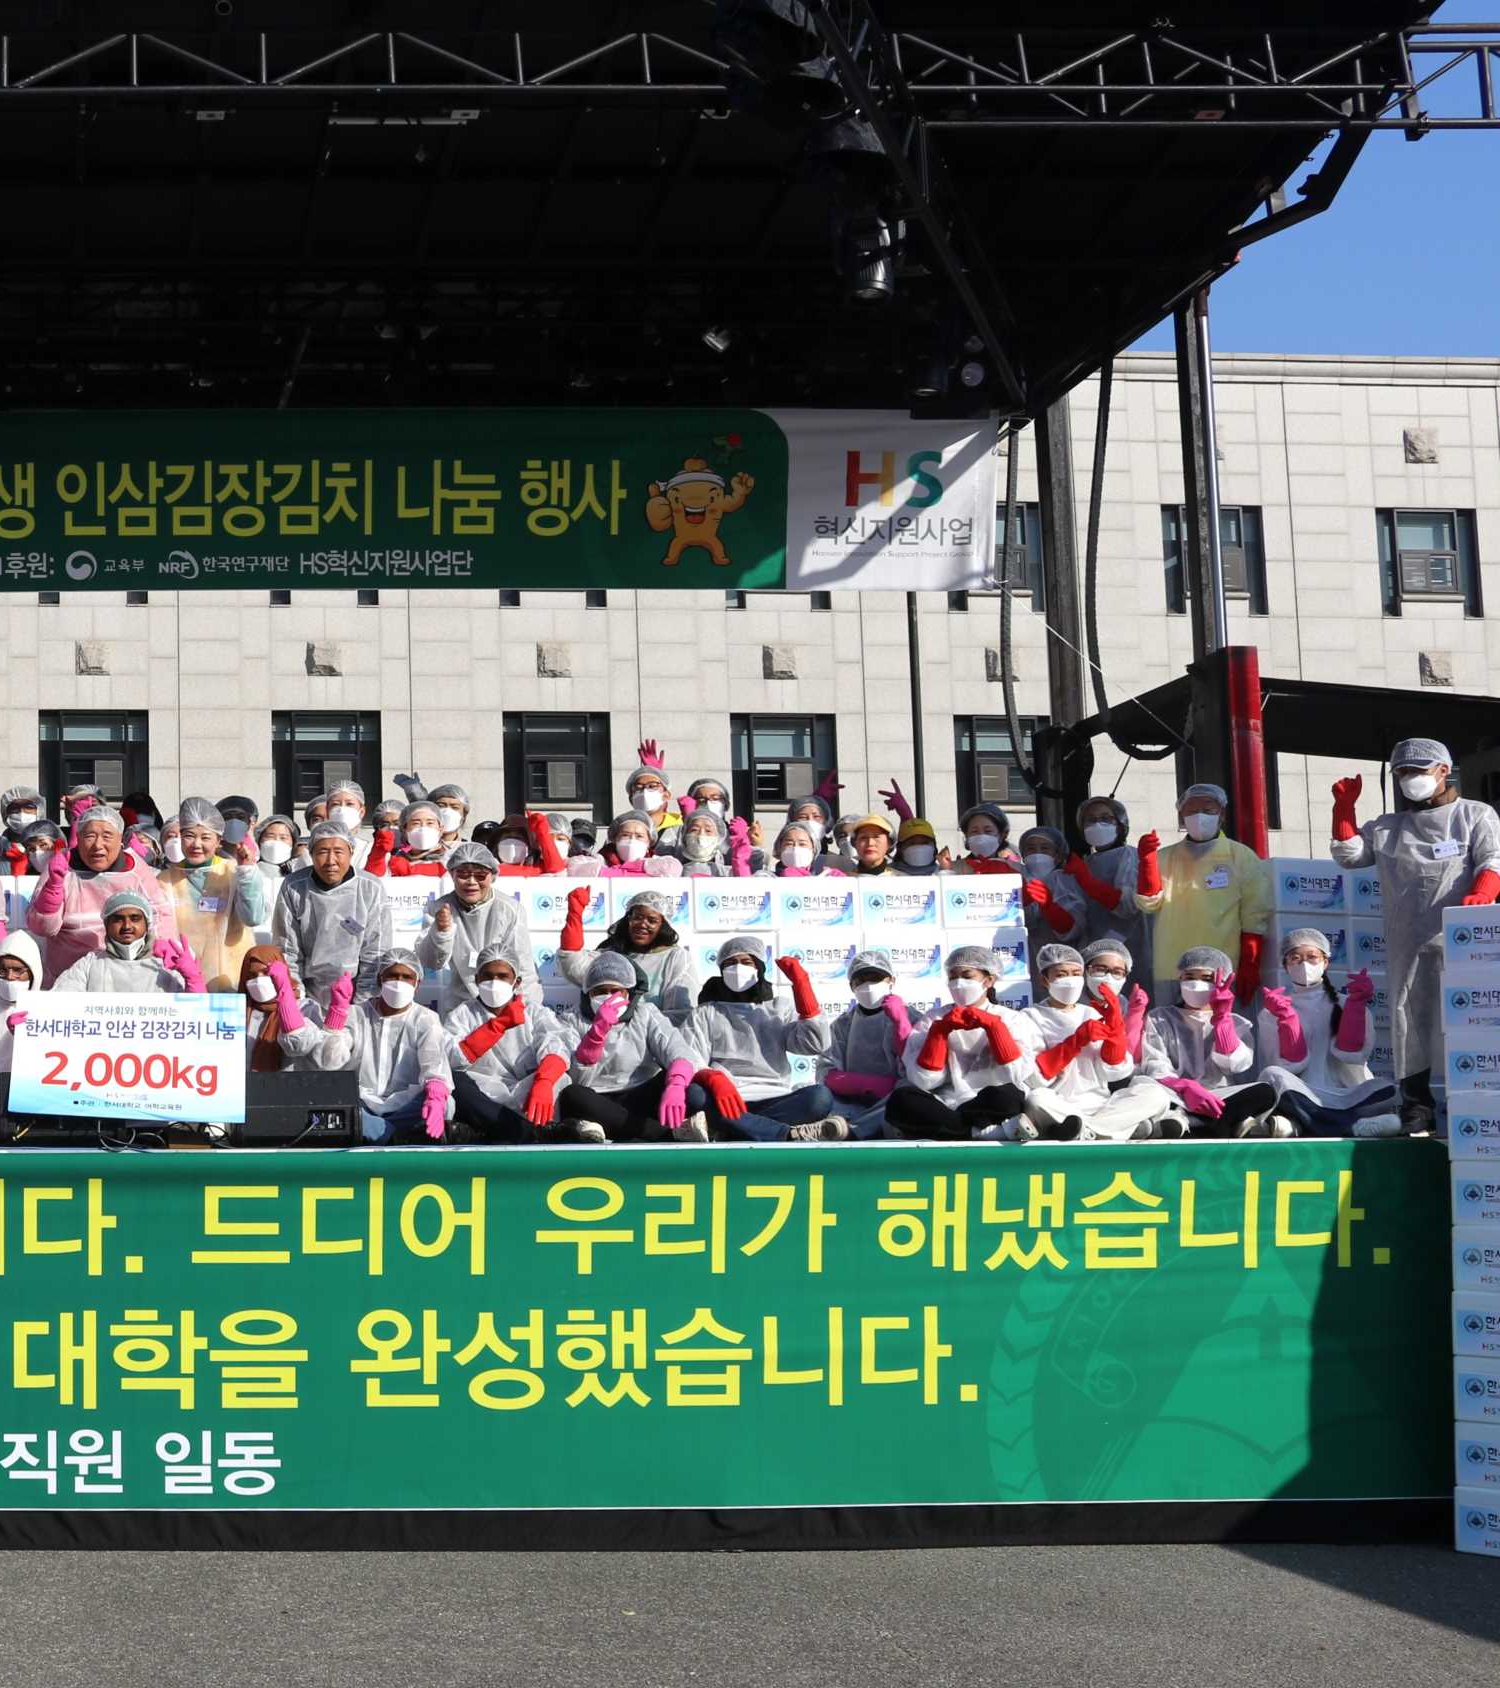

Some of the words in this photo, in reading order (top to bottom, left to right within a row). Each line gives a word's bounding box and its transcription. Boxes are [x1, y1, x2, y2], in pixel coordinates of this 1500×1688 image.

[56, 460, 375, 538] 인삼김장김치
[397, 458, 503, 536] 나눔
[518, 456, 628, 536] 행사
[845, 450, 944, 508] HS
[813, 515, 974, 547] 혁신지원사업
[104, 558, 145, 573] 교육부
[158, 560, 191, 575] NRF
[202, 556, 291, 573] 한국연구재단
[300, 550, 474, 578] HS혁신지원사업단
[25, 1019, 102, 1039] 한서대학교
[105, 1020, 137, 1039] 인삼
[140, 1020, 202, 1041] 김장김치
[205, 1021, 237, 1041] 나눔
[83, 1005, 135, 1016] 지역사회와
[138, 1005, 179, 1017] 함께하는
[41, 1050, 219, 1097] 2,000kg
[190, 1175, 487, 1276] 드디어
[535, 1173, 838, 1275] 우리가
[876, 1169, 1392, 1272] 해냈습니다.
[12, 1308, 310, 1410] 대학을
[349, 1305, 980, 1410] 완성했습니다.
[154, 1429, 283, 1497] 일동
